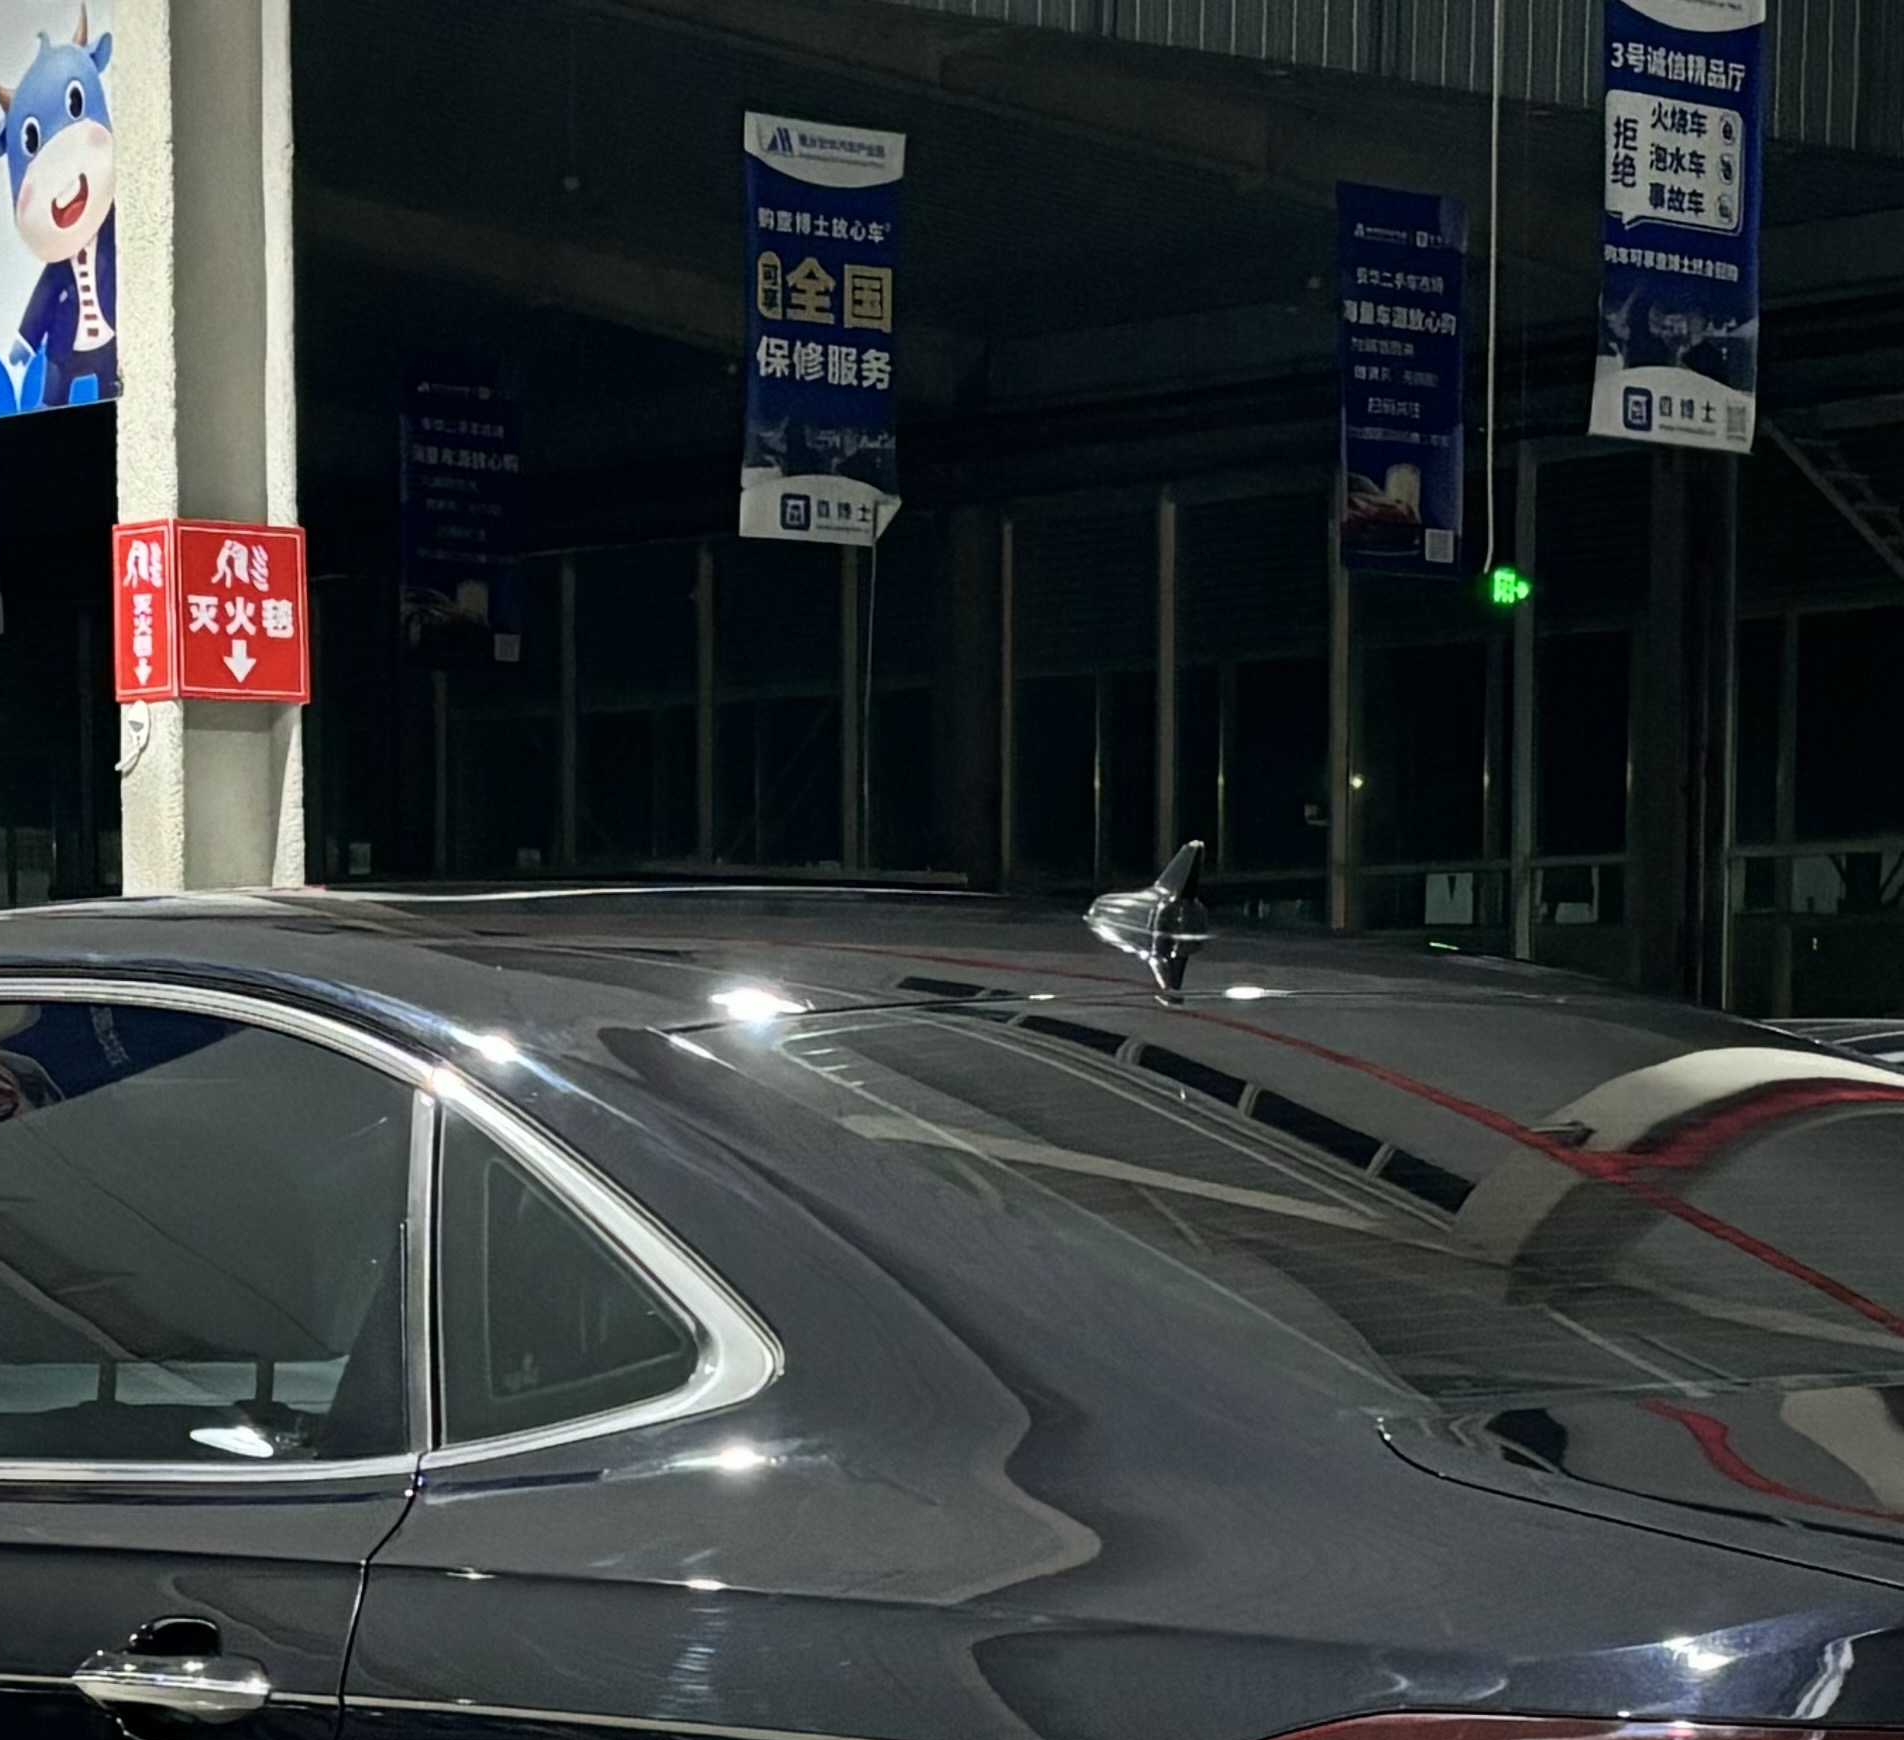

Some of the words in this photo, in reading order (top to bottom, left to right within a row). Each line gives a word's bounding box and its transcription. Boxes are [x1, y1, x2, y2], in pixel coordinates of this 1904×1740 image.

[1651, 101, 1708, 138] 火烧车
[1611, 117, 1639, 188] 拒绝
[1650, 143, 1706, 178] 泡水车
[785, 256, 893, 334] 全国
[756, 334, 893, 390] 保修服务
